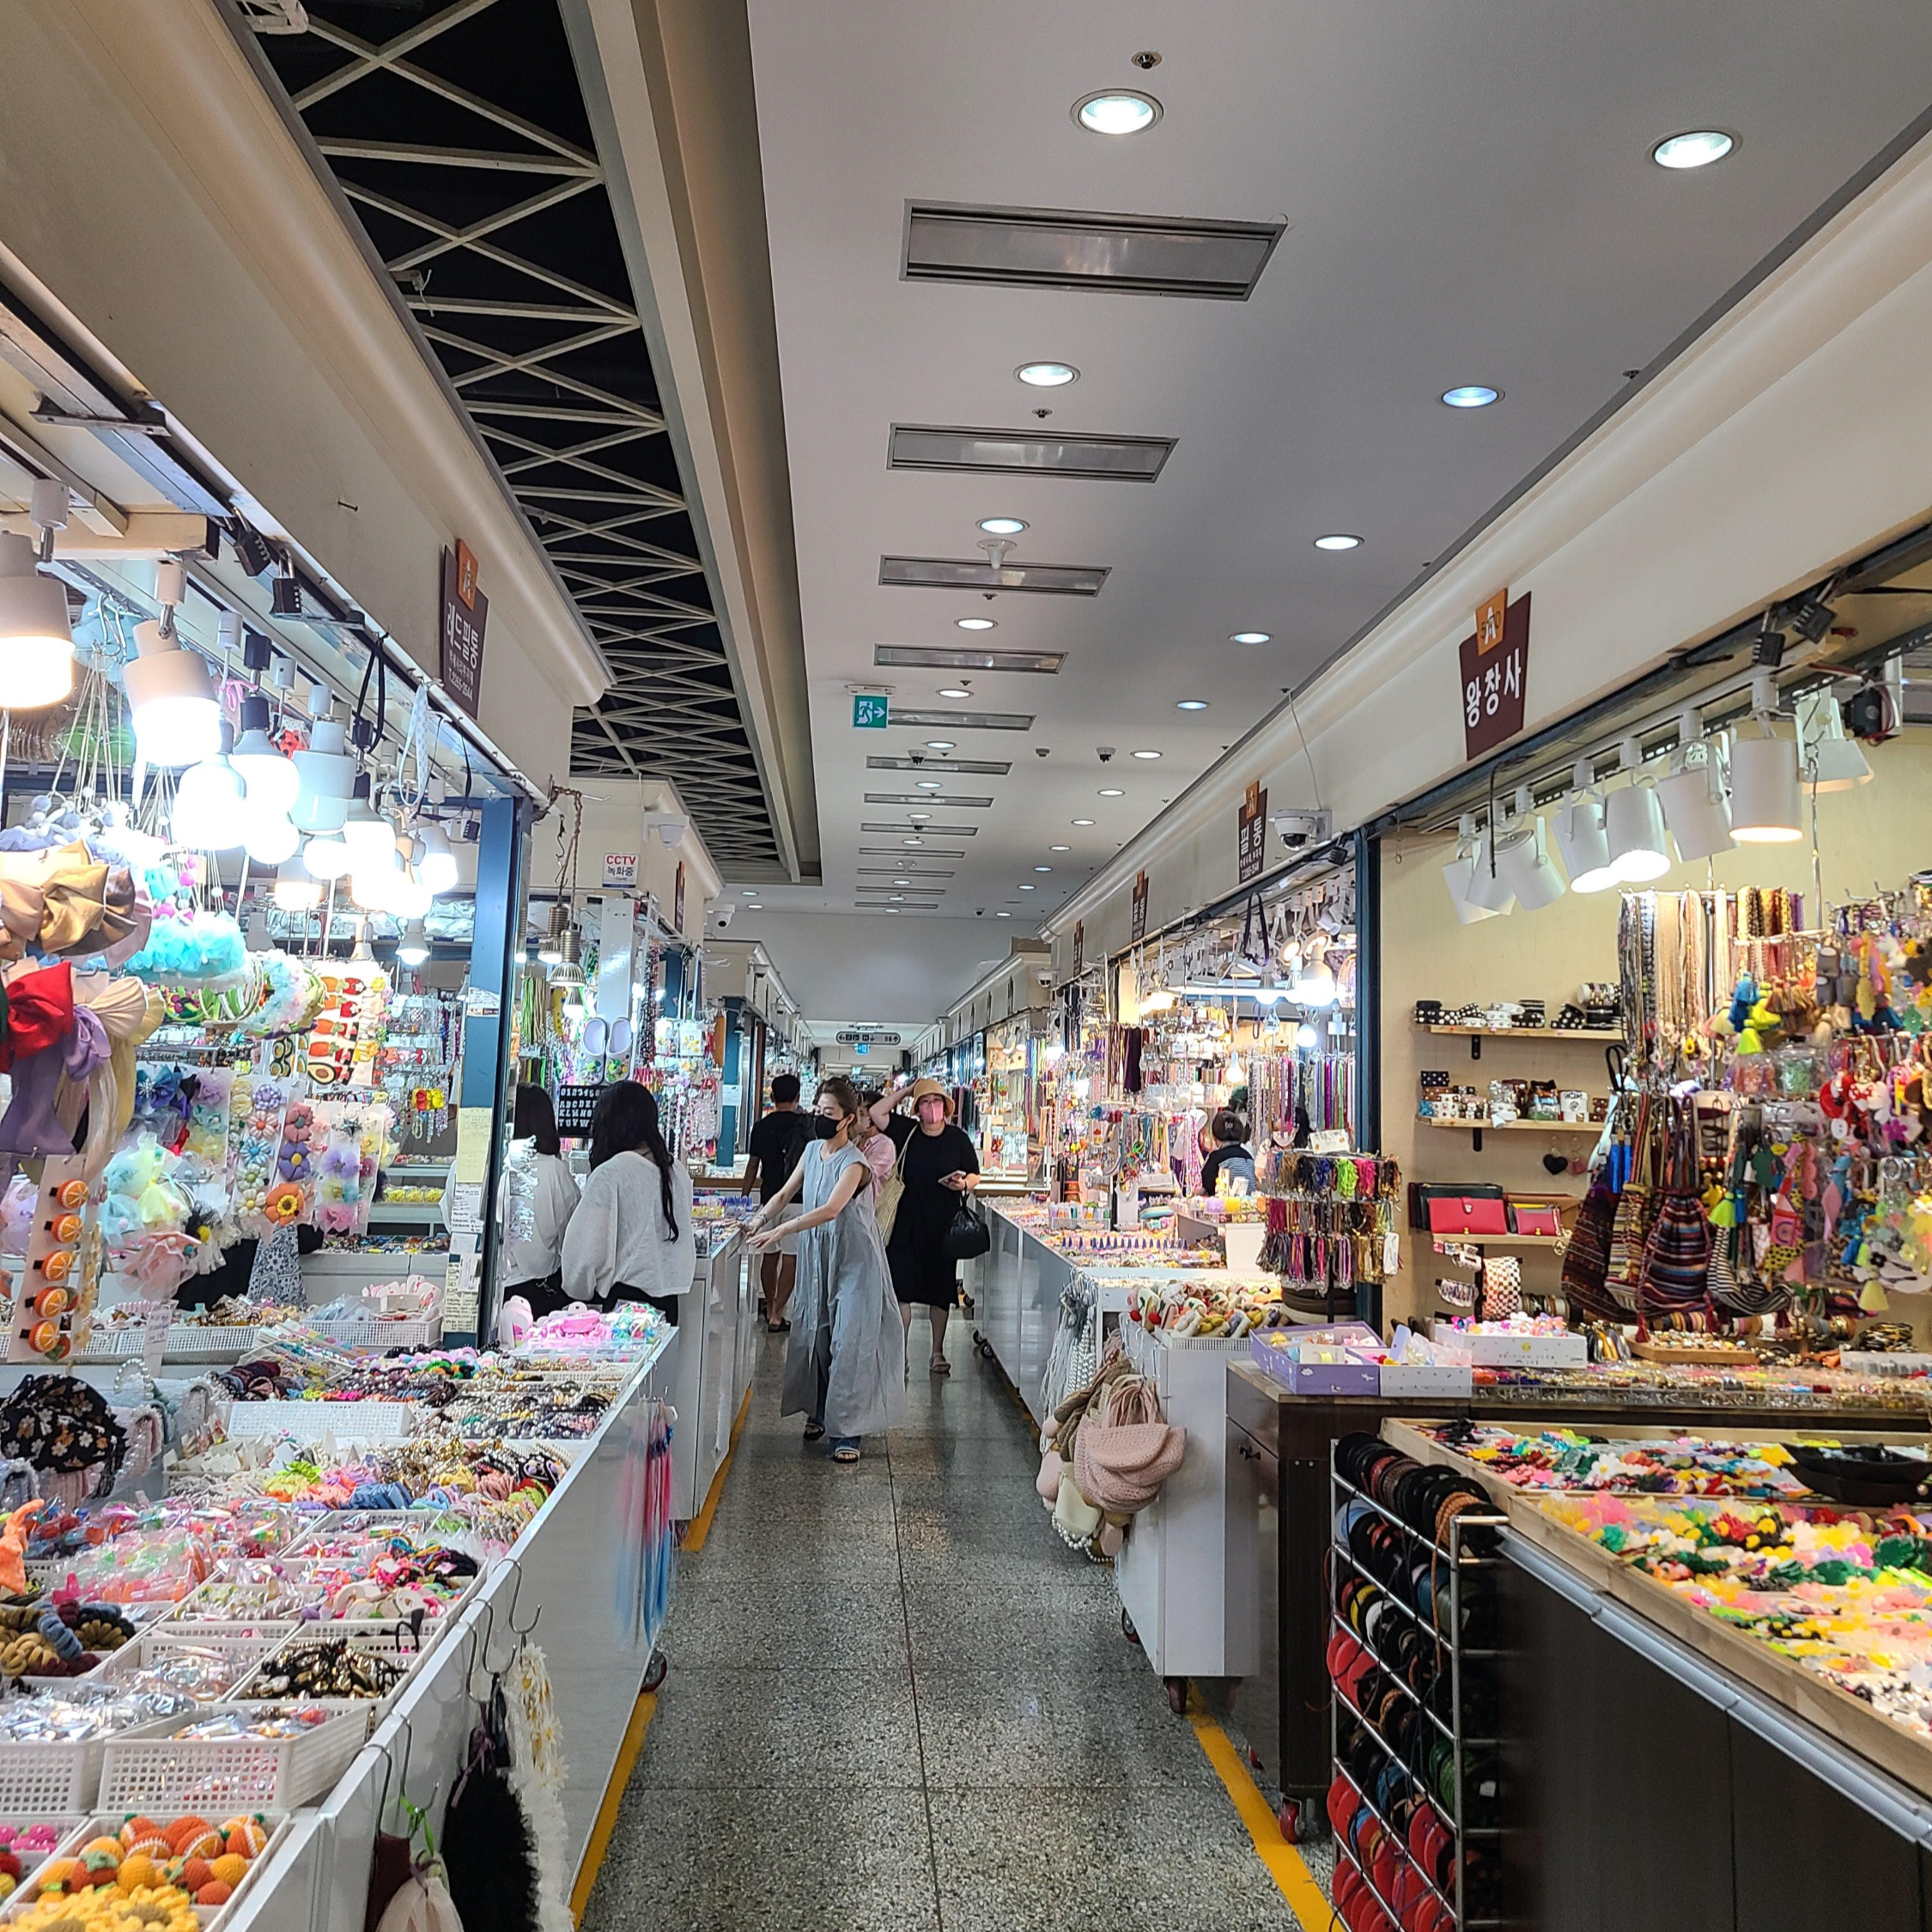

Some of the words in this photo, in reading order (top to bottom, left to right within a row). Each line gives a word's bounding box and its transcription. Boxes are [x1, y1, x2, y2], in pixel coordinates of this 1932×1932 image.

[447, 601, 479, 669] 레드필통
[1466, 647, 1522, 728] 왕창사
[1240, 815, 1263, 856] 필통
[606, 855, 636, 866] CCTV
[607, 866, 634, 877] 녹화중
